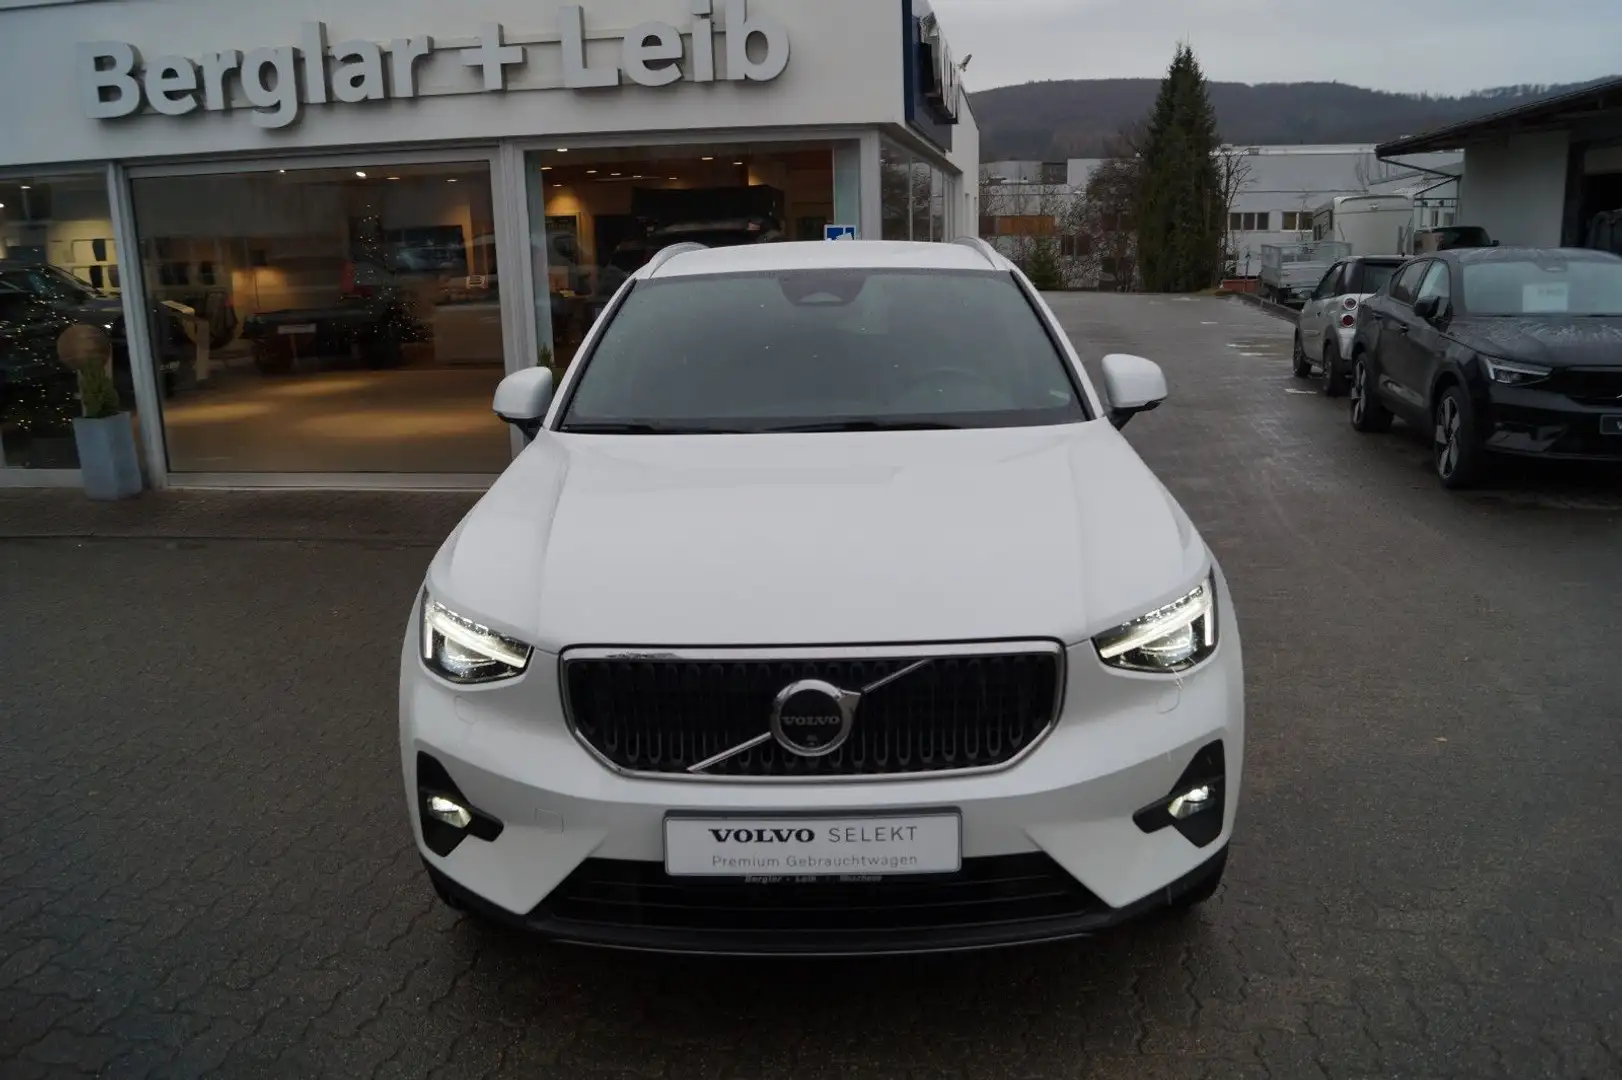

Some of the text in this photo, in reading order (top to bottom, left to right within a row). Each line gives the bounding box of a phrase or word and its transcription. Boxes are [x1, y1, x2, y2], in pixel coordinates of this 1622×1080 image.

[78, 0, 789, 129] Berglar + Leib
[781, 715, 841, 727] VOLVO
[709, 826, 918, 843] VOLVO SELEKT
[712, 855, 917, 870] Premium Gebrauchtwagen
